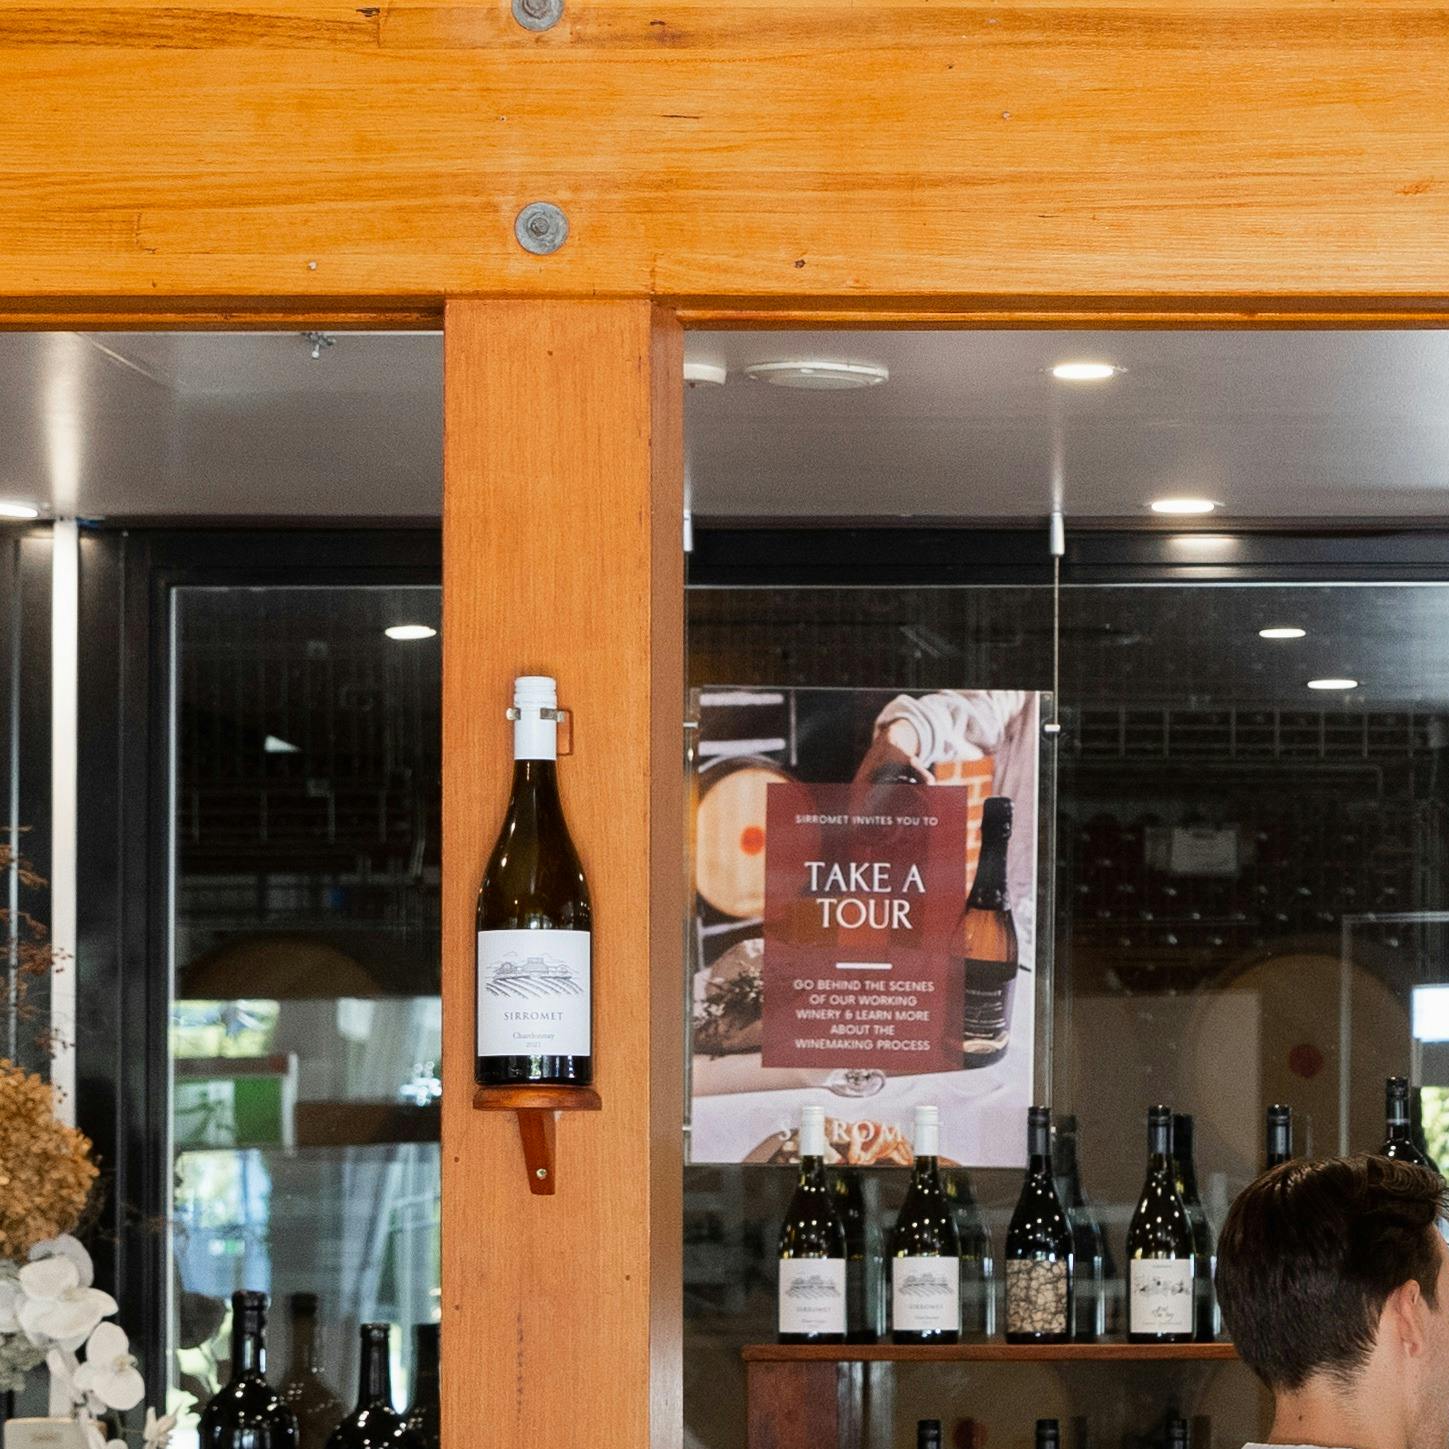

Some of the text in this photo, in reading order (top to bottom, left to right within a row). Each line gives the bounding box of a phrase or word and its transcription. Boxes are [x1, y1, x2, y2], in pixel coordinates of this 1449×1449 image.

[795, 814, 939, 826] SIRROMET INVITES YOU TO
[803, 861, 926, 893] TAKE A
[816, 898, 913, 930] TOUR
[793, 979, 935, 992] GO BEHIND THE SCENES
[809, 995, 918, 1007] OF OUR WORKING
[503, 1011, 563, 1021] SIRROMET
[795, 1009, 930, 1021] WINERY & LEARN MORE
[830, 1024, 895, 1036] ABOUT THE
[794, 1038, 931, 1051] WINEMAKING PROCESS
